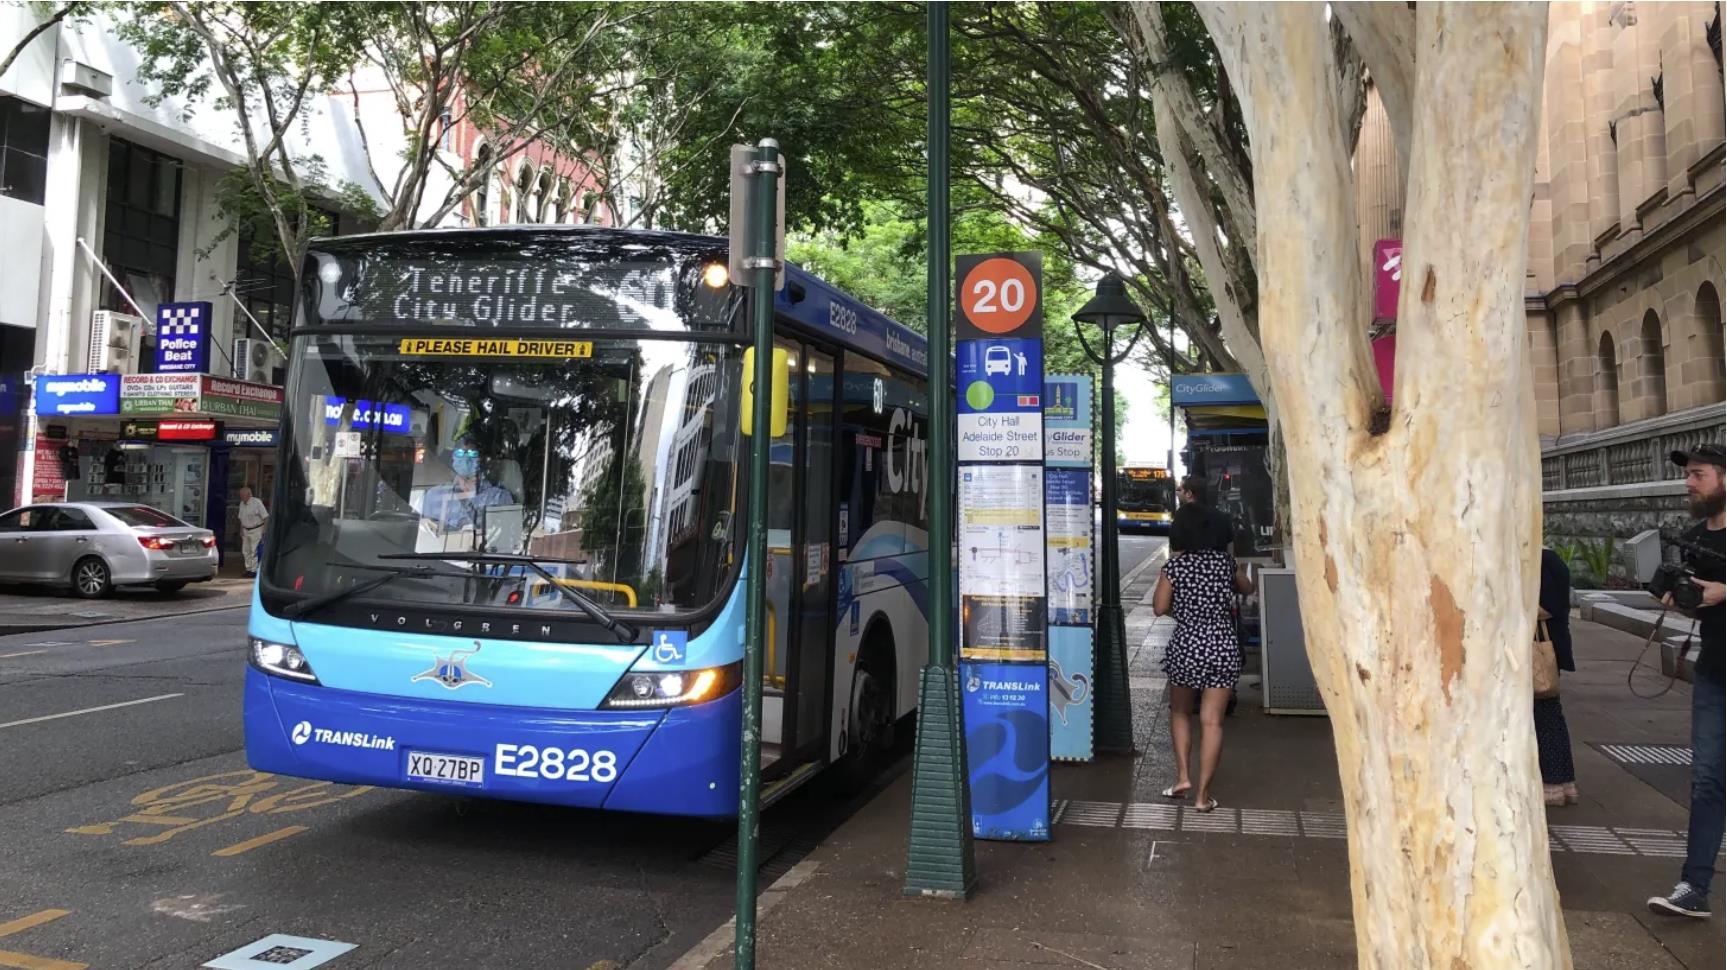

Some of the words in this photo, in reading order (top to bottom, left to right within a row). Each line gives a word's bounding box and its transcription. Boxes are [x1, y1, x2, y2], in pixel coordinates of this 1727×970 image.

[411, 267, 564, 294] Teneriffe
[973, 278, 1025, 313] 20
[394, 294, 457, 320] City
[471, 295, 574, 322] Glider
[829, 301, 857, 336] E2828
[160, 338, 198, 349] Police
[415, 340, 471, 353] PLEASE
[477, 342, 512, 354] HAIL
[517, 343, 575, 356] DRIVER
[164, 350, 193, 361] Beat
[123, 376, 149, 384] RECORD
[211, 380, 241, 395] Record
[241, 384, 277, 400] Exchange
[1175, 383, 1225, 395] CityGlider
[209, 401, 237, 414] URBAN
[240, 404, 258, 416] THAI
[978, 416, 998, 428] City
[1001, 416, 1020, 427] Hall
[226, 431, 273, 446] mymobile
[963, 431, 1003, 442] Adelaide
[1006, 431, 1038, 441] Street
[1046, 431, 1086, 444] yGlider
[979, 445, 1003, 457] Stop
[1006, 445, 1019, 457] 20
[1057, 446, 1081, 458] Stop
[371, 614, 551, 635] VOLGREN
[982, 680, 1041, 691] TRANSLink
[314, 728, 396, 751] TRANSLink
[494, 743, 618, 783] E2828
